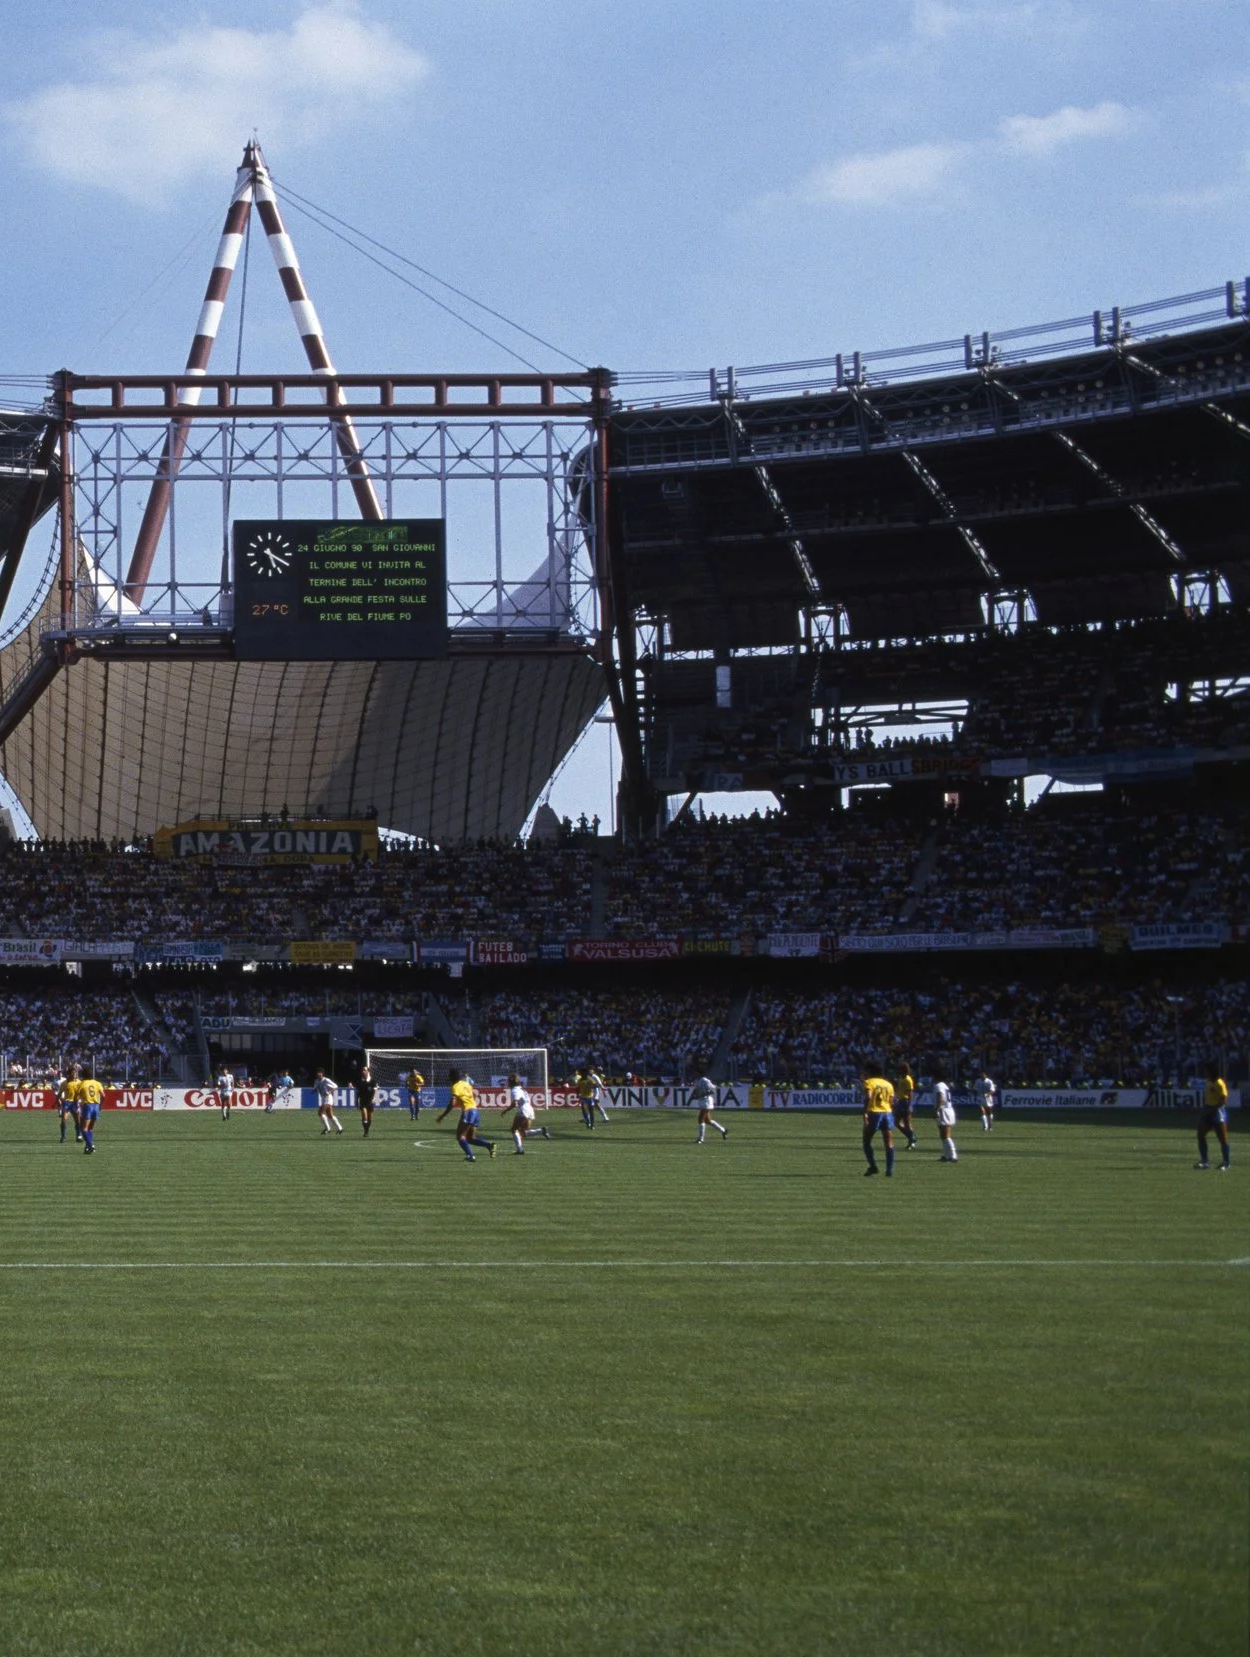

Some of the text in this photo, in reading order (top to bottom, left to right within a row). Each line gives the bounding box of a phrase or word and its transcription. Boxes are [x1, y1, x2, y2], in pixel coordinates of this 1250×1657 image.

[298, 543, 436, 552] 24 GIUGNO 90 SAN GIOVANNI
[309, 561, 427, 570] IL COMUNE VI INVITA AL
[309, 578, 427, 587] TERMINE DELL' INCONTRO
[303, 595, 427, 604] ALLA GRANDE FESTA SULLE
[320, 612, 412, 621] RIVE DEL FIUME PO
[180, 831, 354, 857] AMAZONIA
[1138, 923, 1213, 937] QUILMES
[3, 942, 37, 953] Brasil
[581, 948, 672, 959] VALSUSA
[478, 952, 527, 963] BAILADO
[87, 1085, 96, 1098] 6
[318, 1088, 401, 1107] HIPS
[471, 1088, 582, 1107] Budeise
[607, 1087, 741, 1107] VINI ITAIA
[1142, 1088, 1205, 1107] Alital
[6, 1091, 44, 1108] JVC
[116, 1091, 153, 1108] JVC
[183, 1090, 272, 1108] Caon
[767, 1091, 861, 1108] TV RADIOCORR
[1003, 1095, 1096, 1105] Ferrovie Italiane
